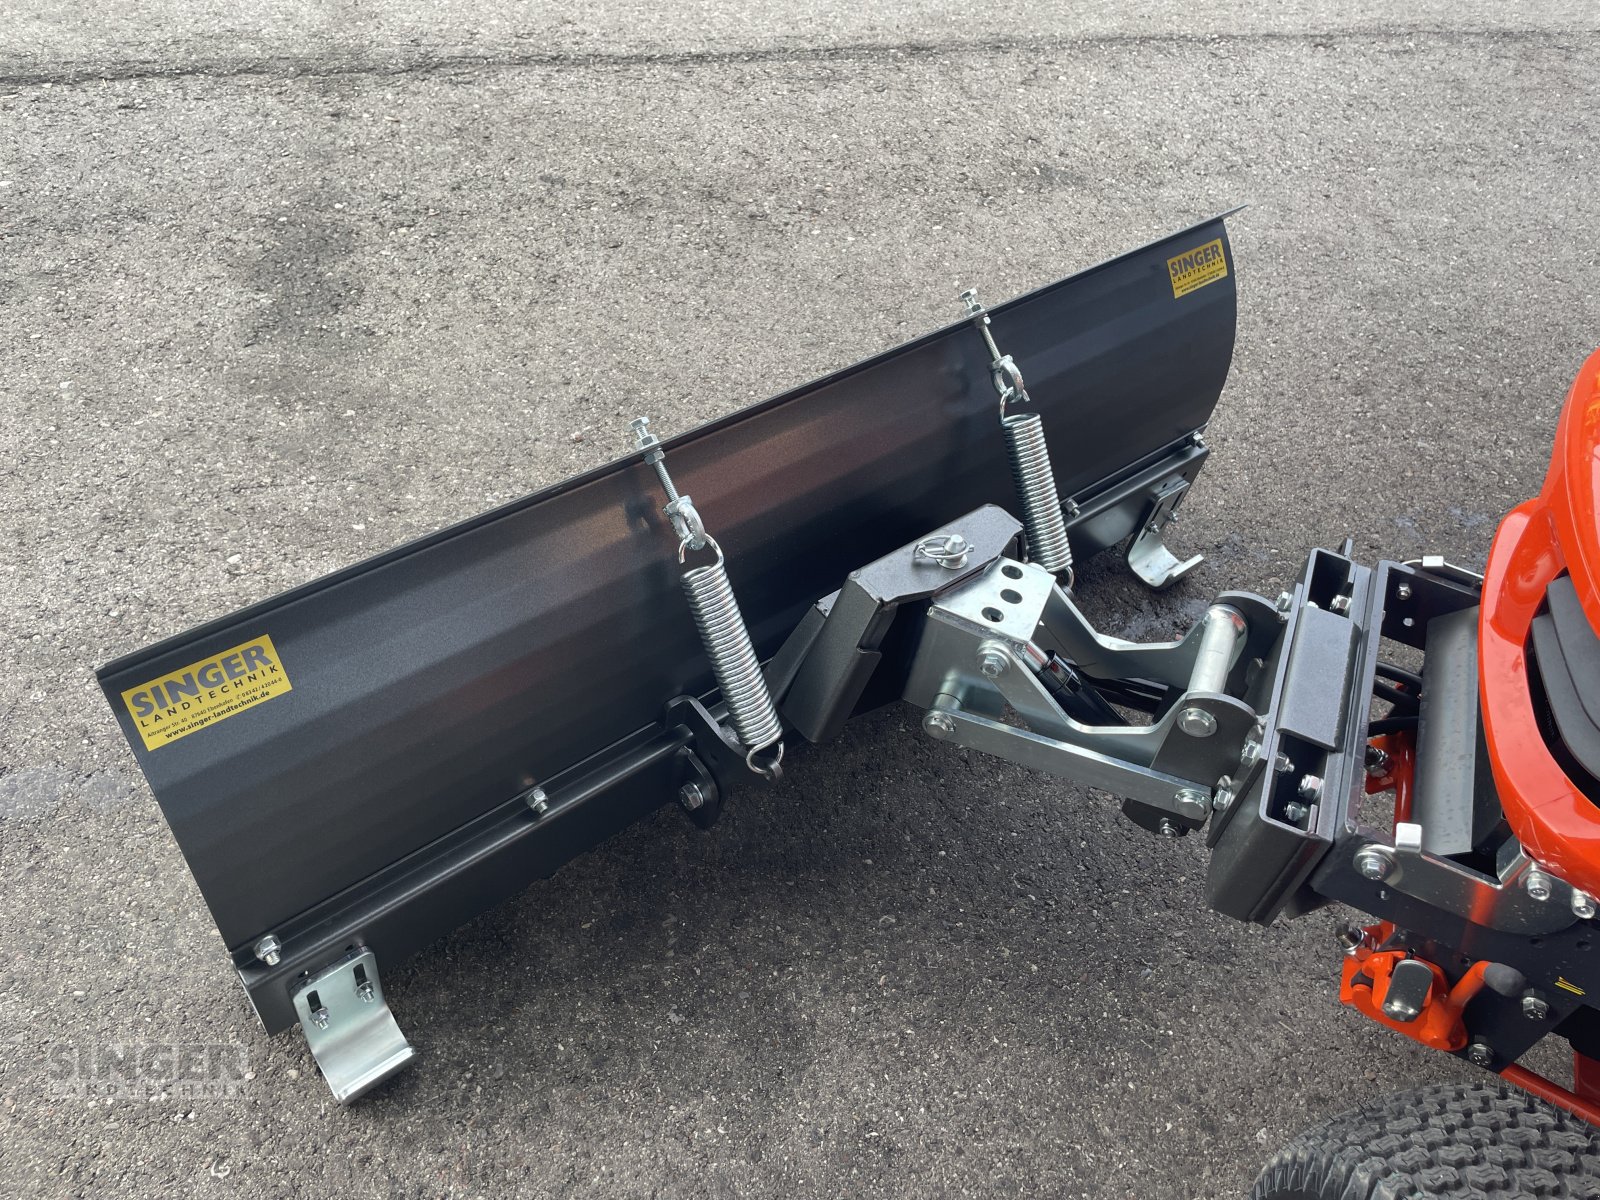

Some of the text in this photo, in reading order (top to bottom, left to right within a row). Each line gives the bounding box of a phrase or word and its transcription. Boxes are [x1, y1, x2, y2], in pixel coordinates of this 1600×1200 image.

[1170, 244, 1221, 278] SINGER
[1172, 258, 1224, 283] LANDTECHNIK
[131, 645, 273, 718] SINGER
[140, 665, 279, 728] LANDTECHNIK
[165, 690, 270, 739] www.singer-landtechnik.de
